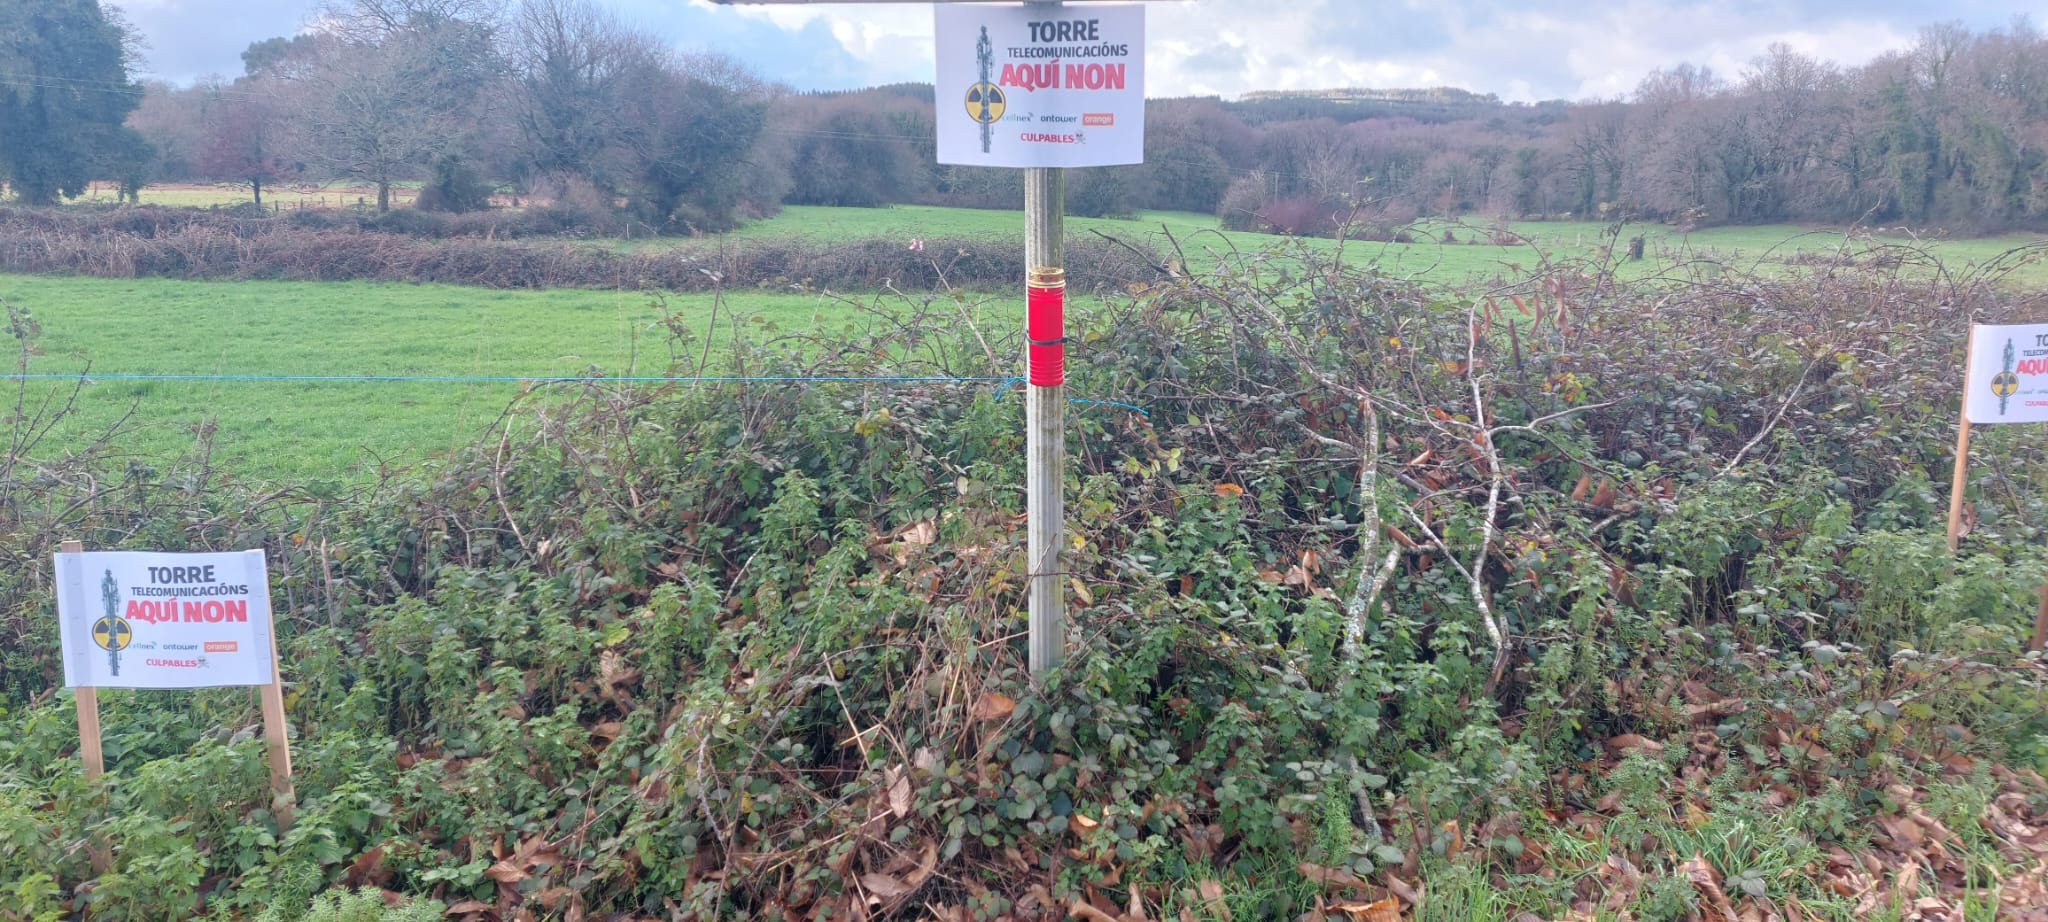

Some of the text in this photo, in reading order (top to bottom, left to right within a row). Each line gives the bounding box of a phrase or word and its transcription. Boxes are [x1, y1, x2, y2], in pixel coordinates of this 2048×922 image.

[1028, 19, 1099, 42] TORRE
[1008, 42, 1128, 58] TELECOMUNICACIÓNS
[999, 59, 1125, 92] AQUÍ NON
[1040, 115, 1077, 123] ontower
[1085, 115, 1112, 124] orange
[1020, 132, 1074, 143] CULPABLES
[148, 565, 215, 584] TORRE
[131, 583, 249, 597] TELECOMUNICACIÓNS
[125, 598, 247, 624] AQUÍ NON
[146, 658, 197, 667] CULPABLES
